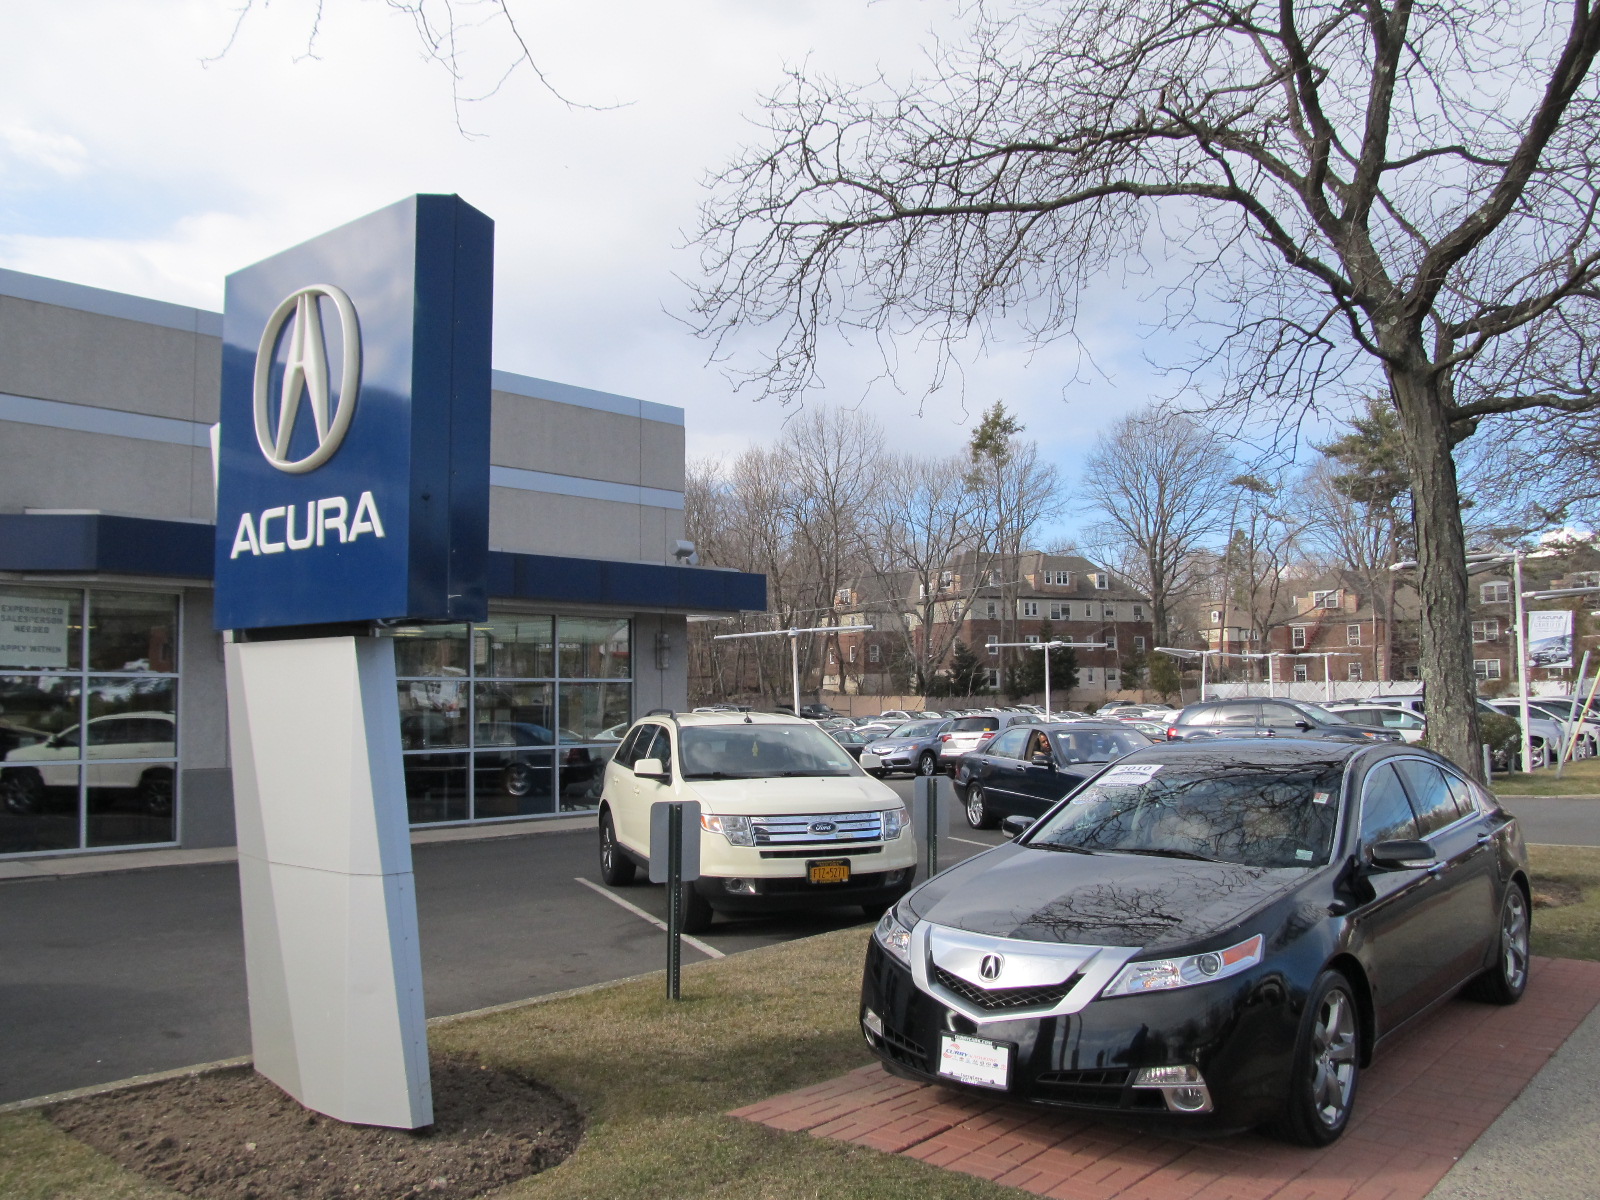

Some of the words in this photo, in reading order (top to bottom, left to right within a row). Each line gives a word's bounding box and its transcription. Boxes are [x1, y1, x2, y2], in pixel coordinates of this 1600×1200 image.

[230, 490, 386, 560] ACURA
[14, 625, 49, 633] NEEDED
[945, 1048, 969, 1057] CURRY
